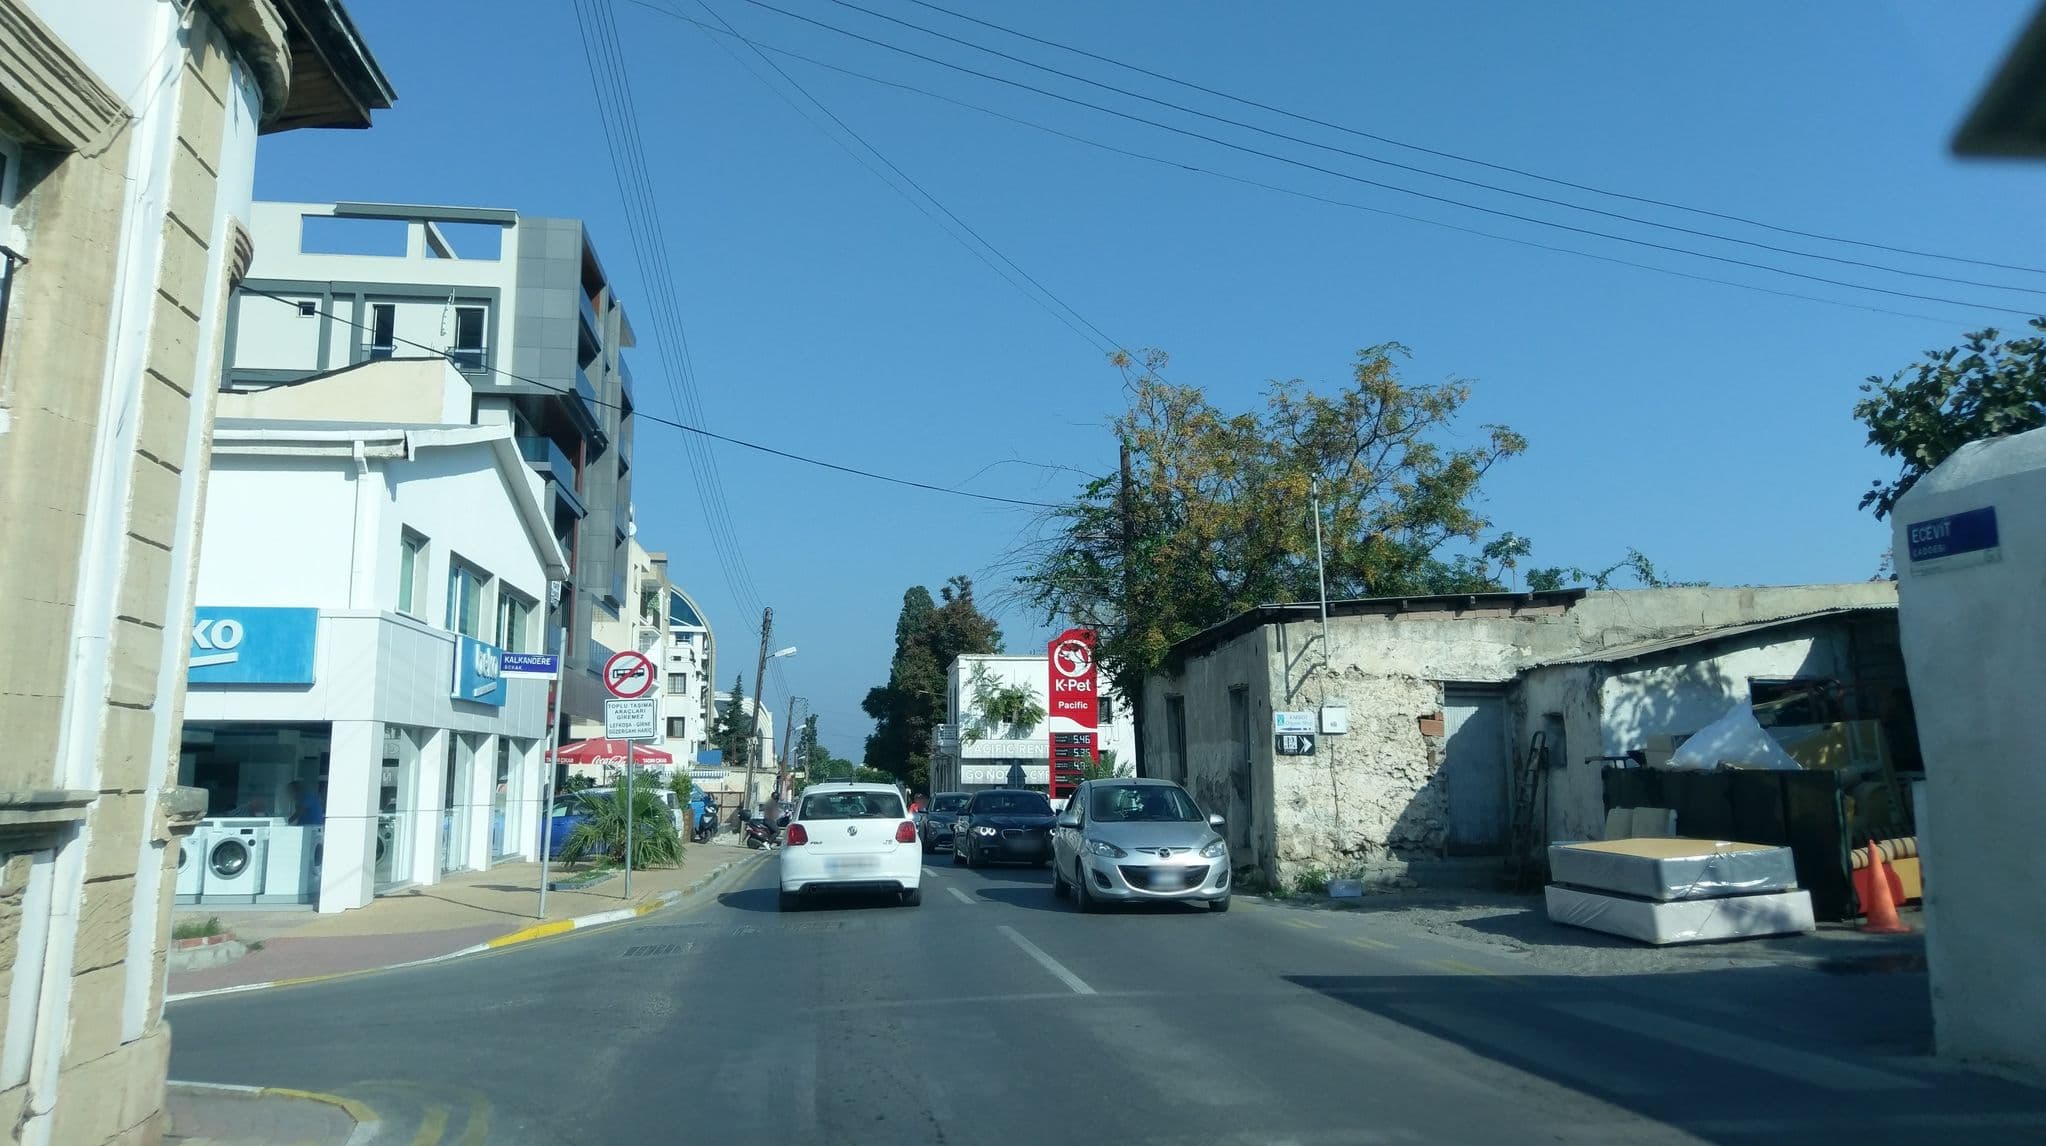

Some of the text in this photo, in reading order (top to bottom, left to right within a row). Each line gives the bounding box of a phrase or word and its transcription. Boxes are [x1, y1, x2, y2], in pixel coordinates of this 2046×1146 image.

[504, 656, 552, 665] KALKANDERE
[1055, 679, 1092, 692] K-Pet
[1058, 701, 1088, 709] Pacific
[966, 770, 984, 779] GO
